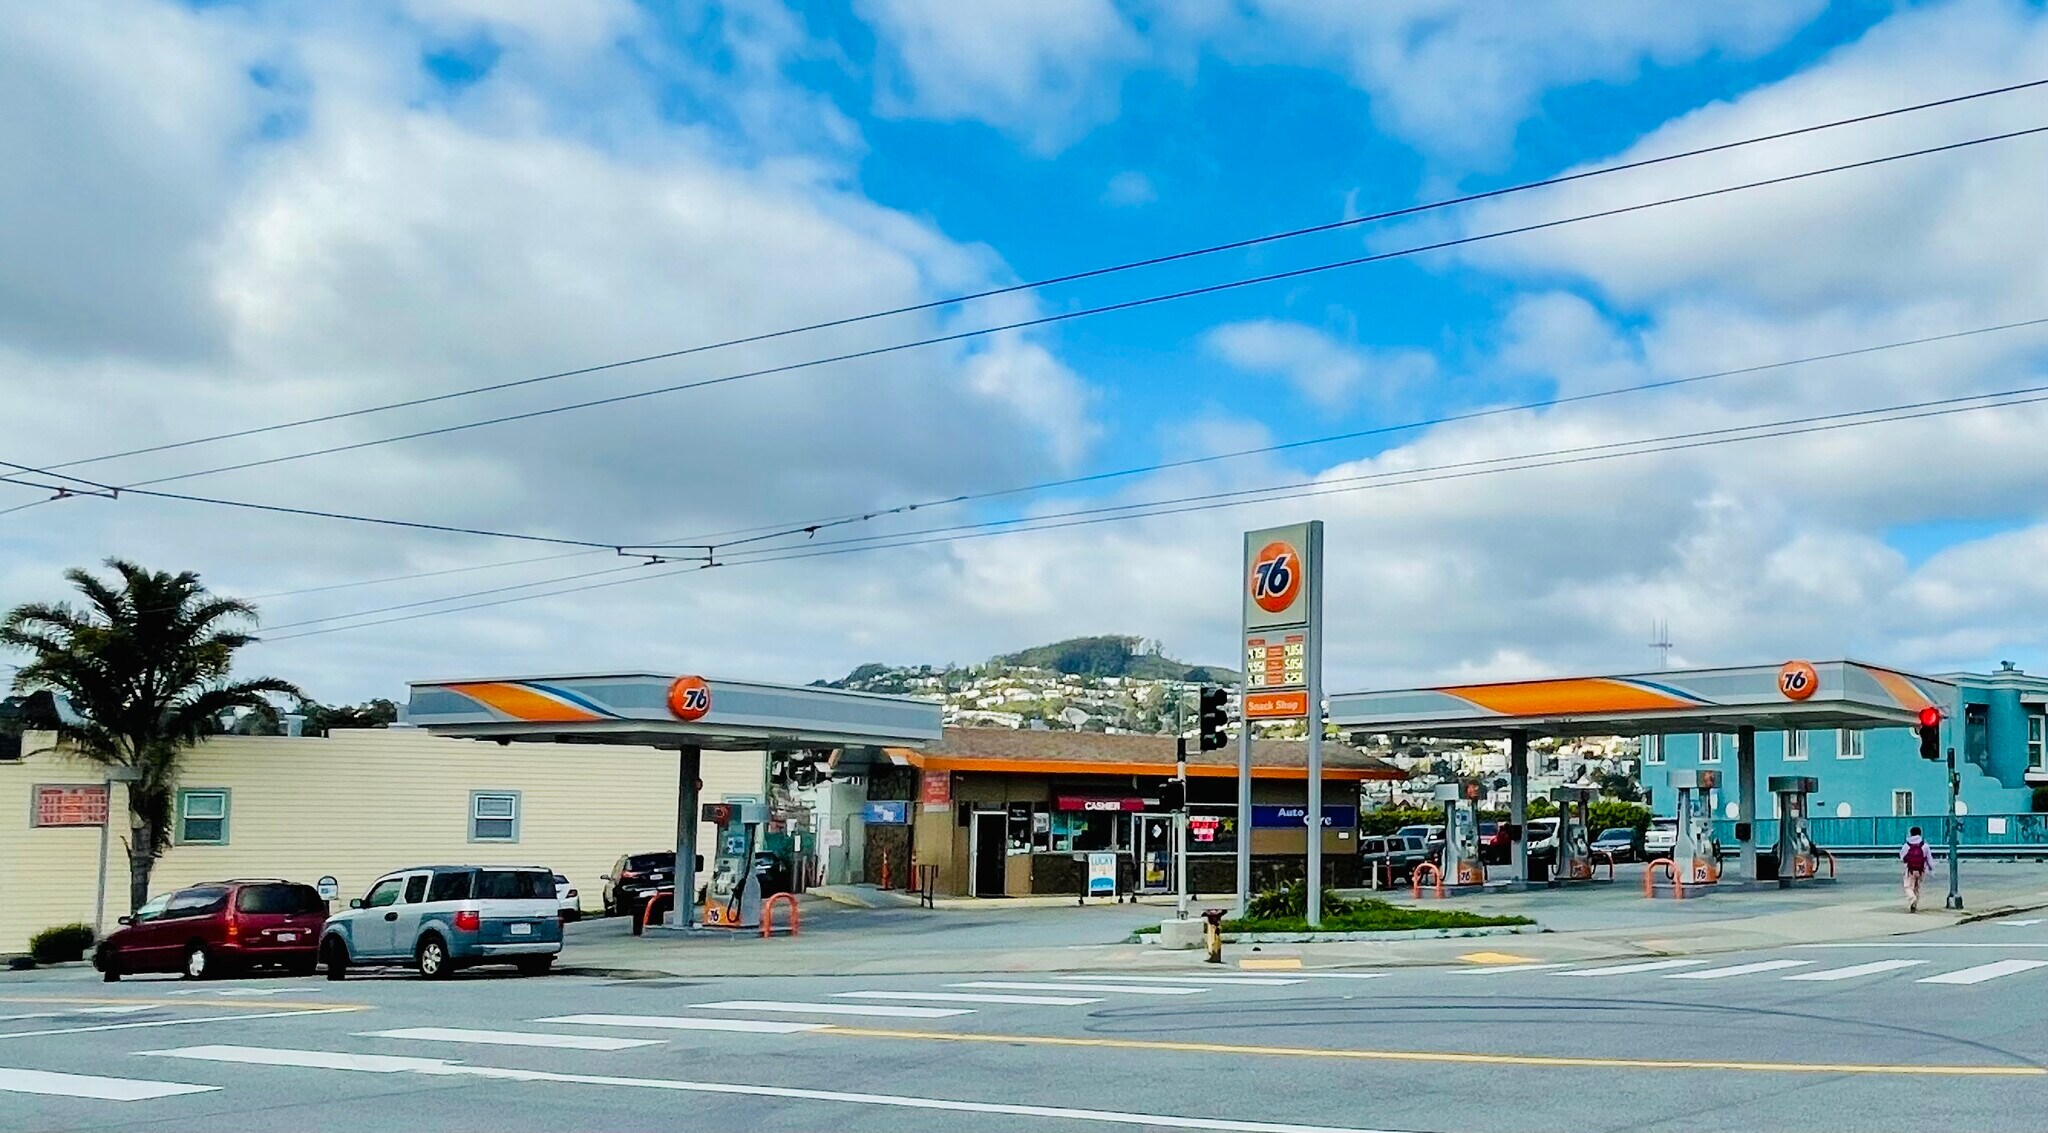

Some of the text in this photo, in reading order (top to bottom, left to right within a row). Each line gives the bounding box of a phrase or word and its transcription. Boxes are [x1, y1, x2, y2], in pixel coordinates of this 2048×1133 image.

[1254, 553, 1292, 599] 76
[1782, 669, 1807, 692] 76
[682, 688, 708, 711] 76
[1248, 700, 1299, 711] Snack Shop
[1084, 802, 1120, 811] CASHIER
[1278, 808, 1304, 817] Auto
[1303, 815, 1332, 825] Cre
[1460, 870, 1471, 881] 76
[1696, 867, 1707, 880] 76
[707, 908, 720, 923] 76
